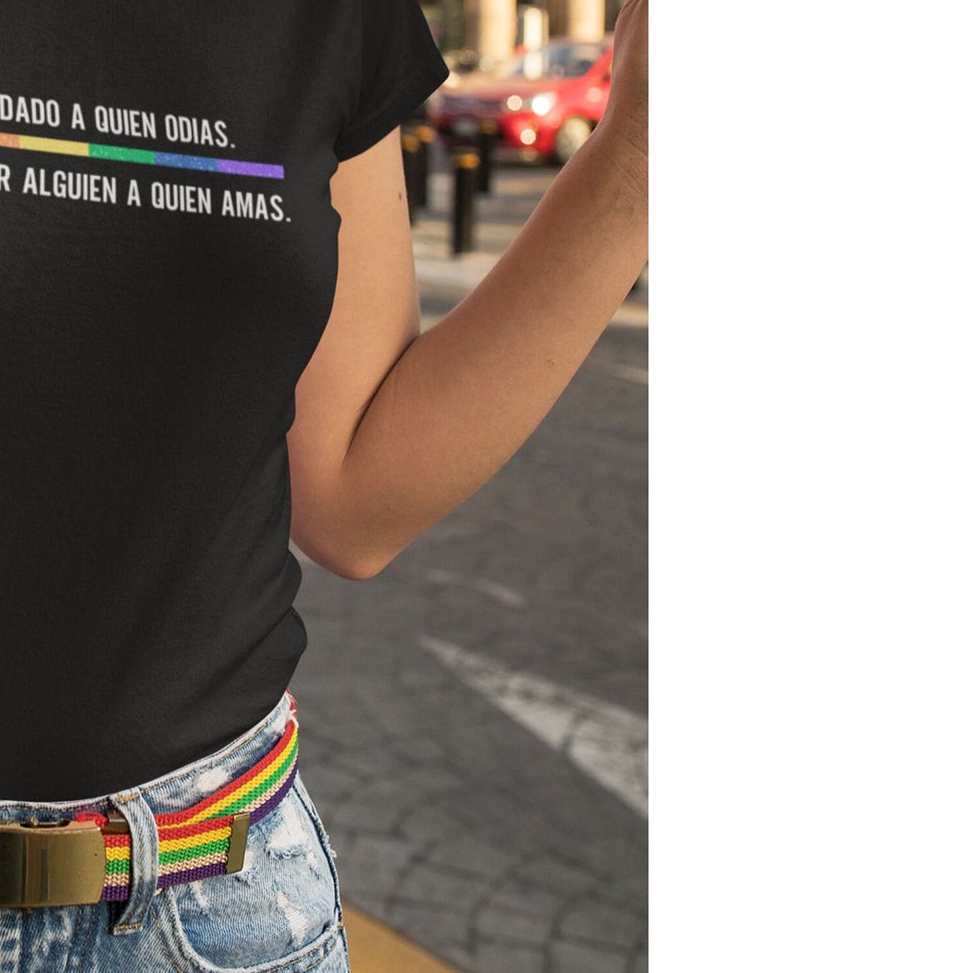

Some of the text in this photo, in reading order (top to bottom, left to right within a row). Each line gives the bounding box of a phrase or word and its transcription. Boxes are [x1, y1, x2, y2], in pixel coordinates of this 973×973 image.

[71, 103, 86, 131] A
[94, 105, 157, 139] QUIEN
[164, 114, 236, 149] ODIAS.
[22, 167, 117, 204] ALGUIEN
[127, 179, 141, 207] A
[151, 181, 212, 215] QUIEN
[221, 190, 292, 223] AMAS.
